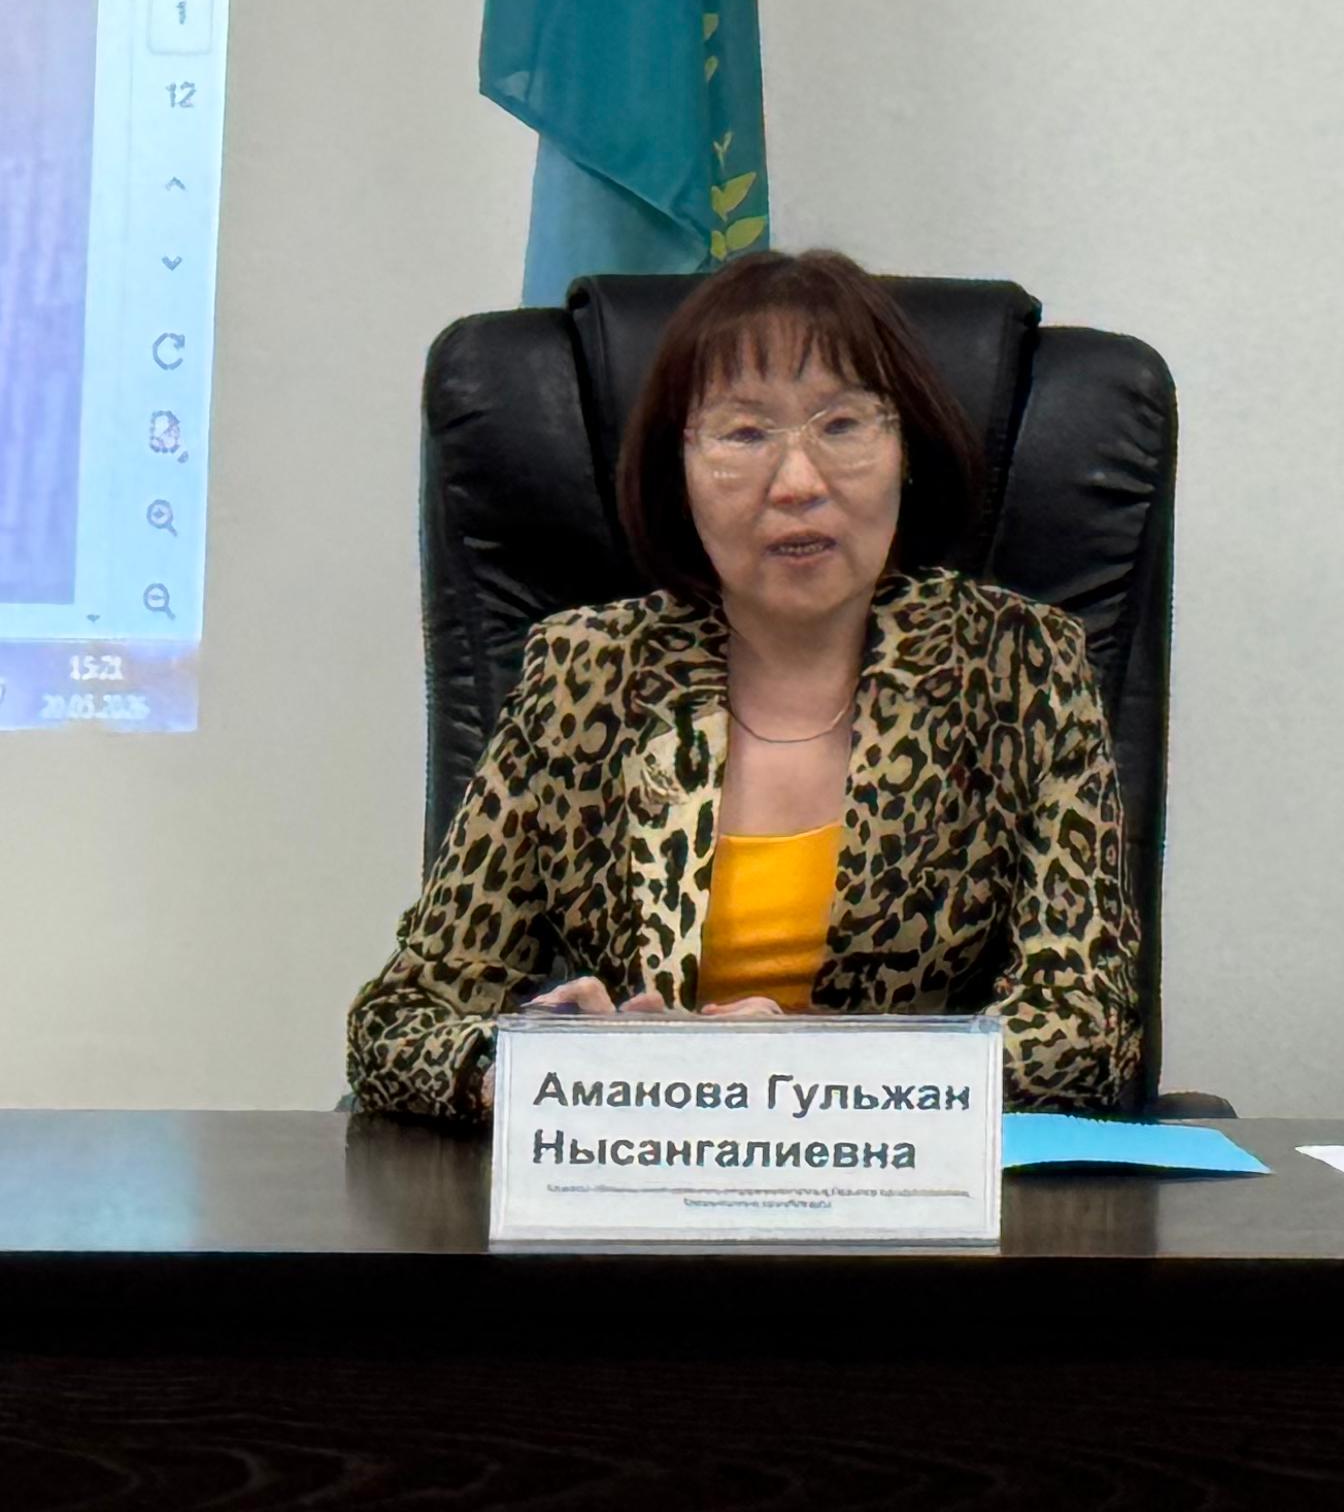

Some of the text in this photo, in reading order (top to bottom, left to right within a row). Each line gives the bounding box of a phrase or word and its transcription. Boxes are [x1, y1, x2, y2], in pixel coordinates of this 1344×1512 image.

[176, 0, 187, 25] 1
[165, 81, 197, 108] 12
[532, 1071, 971, 1119] Аманова Гульжан
[532, 1128, 917, 1169] Нысангалиевна
